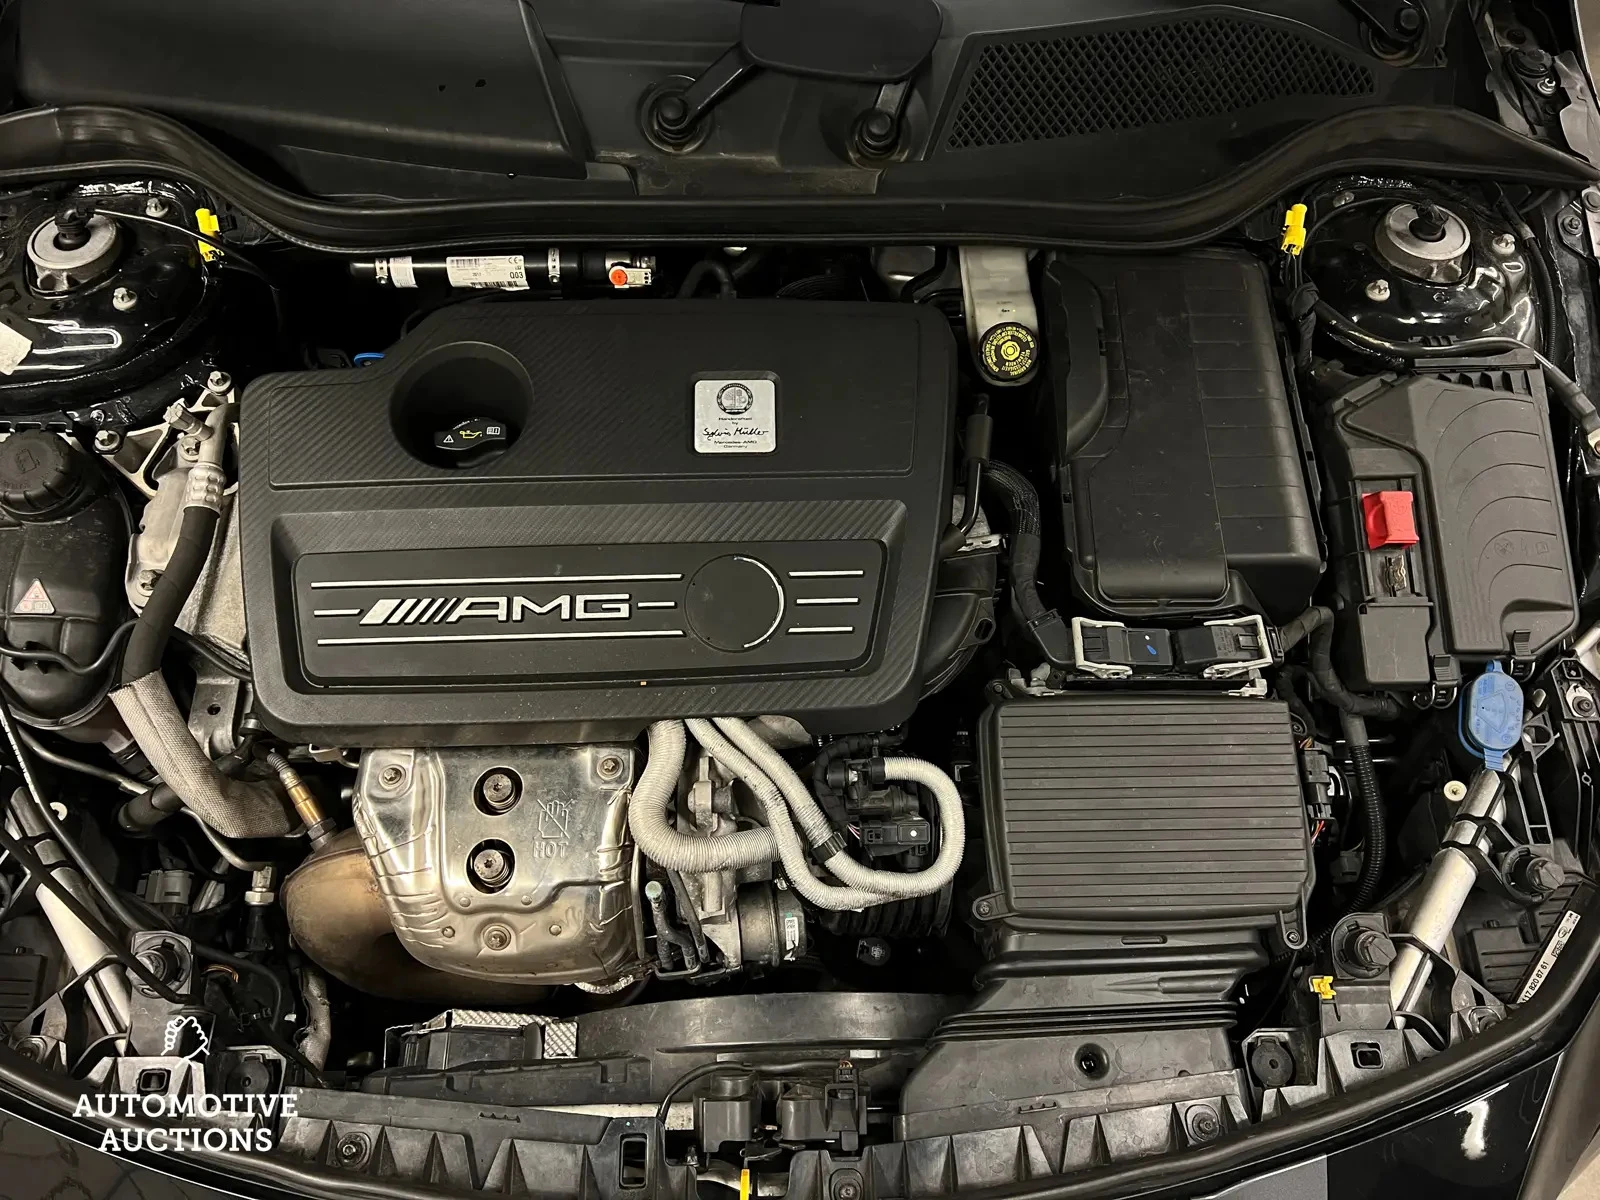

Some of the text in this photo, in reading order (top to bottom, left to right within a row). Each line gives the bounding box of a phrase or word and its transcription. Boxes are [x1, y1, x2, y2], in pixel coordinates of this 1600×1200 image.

[533, 841, 569, 858] HOT
[1529, 978, 1539, 990] 820
[1541, 961, 1549, 969] 61
